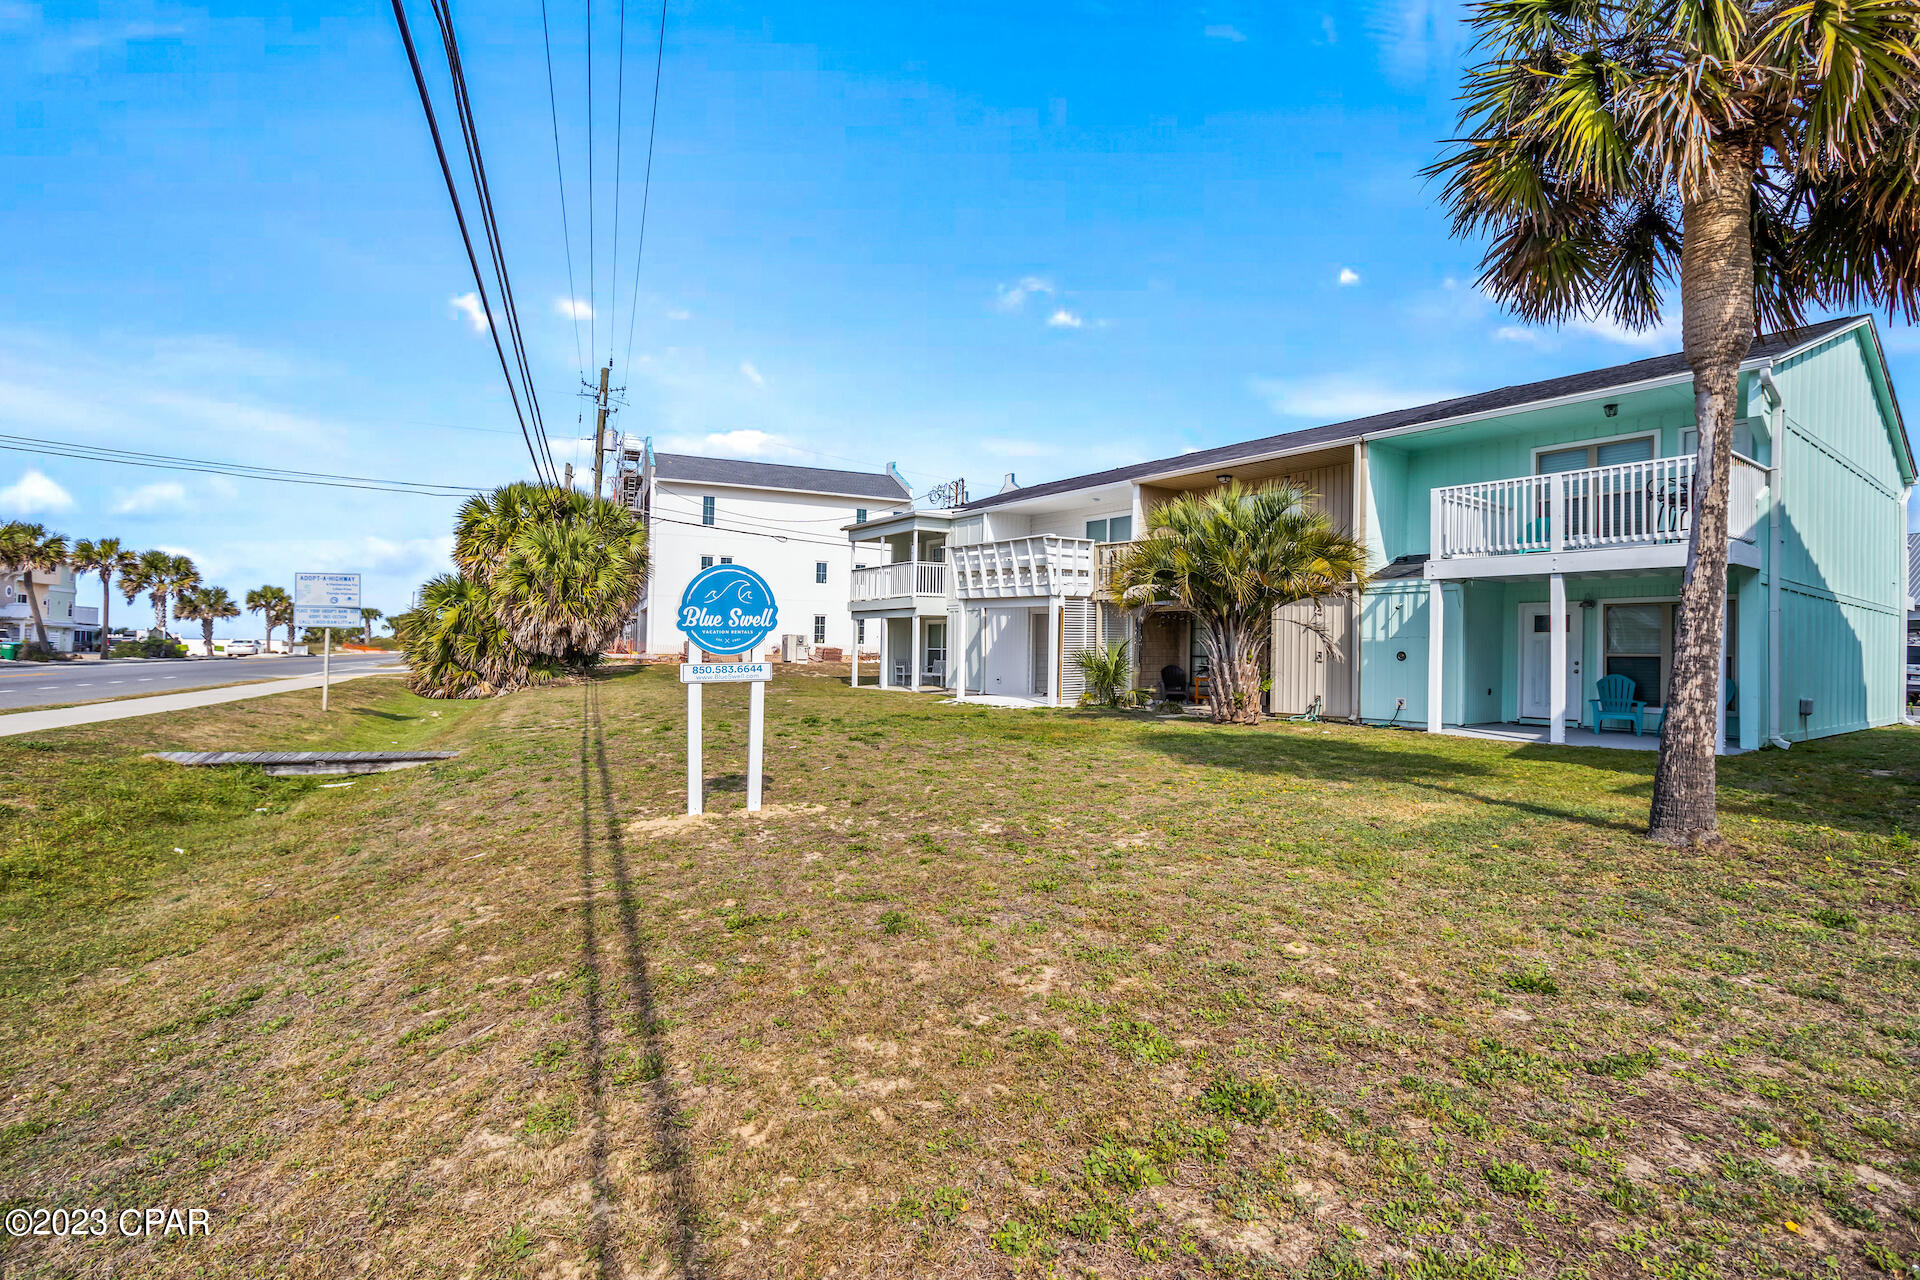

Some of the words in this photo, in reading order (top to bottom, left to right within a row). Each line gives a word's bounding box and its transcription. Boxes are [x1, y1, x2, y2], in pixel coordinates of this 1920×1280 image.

[682, 606, 724, 627] Blue
[728, 607, 773, 627] Swell
[692, 664, 763, 675] 850.583.6644
[695, 673, 760, 681] www.BlueSwell.com
